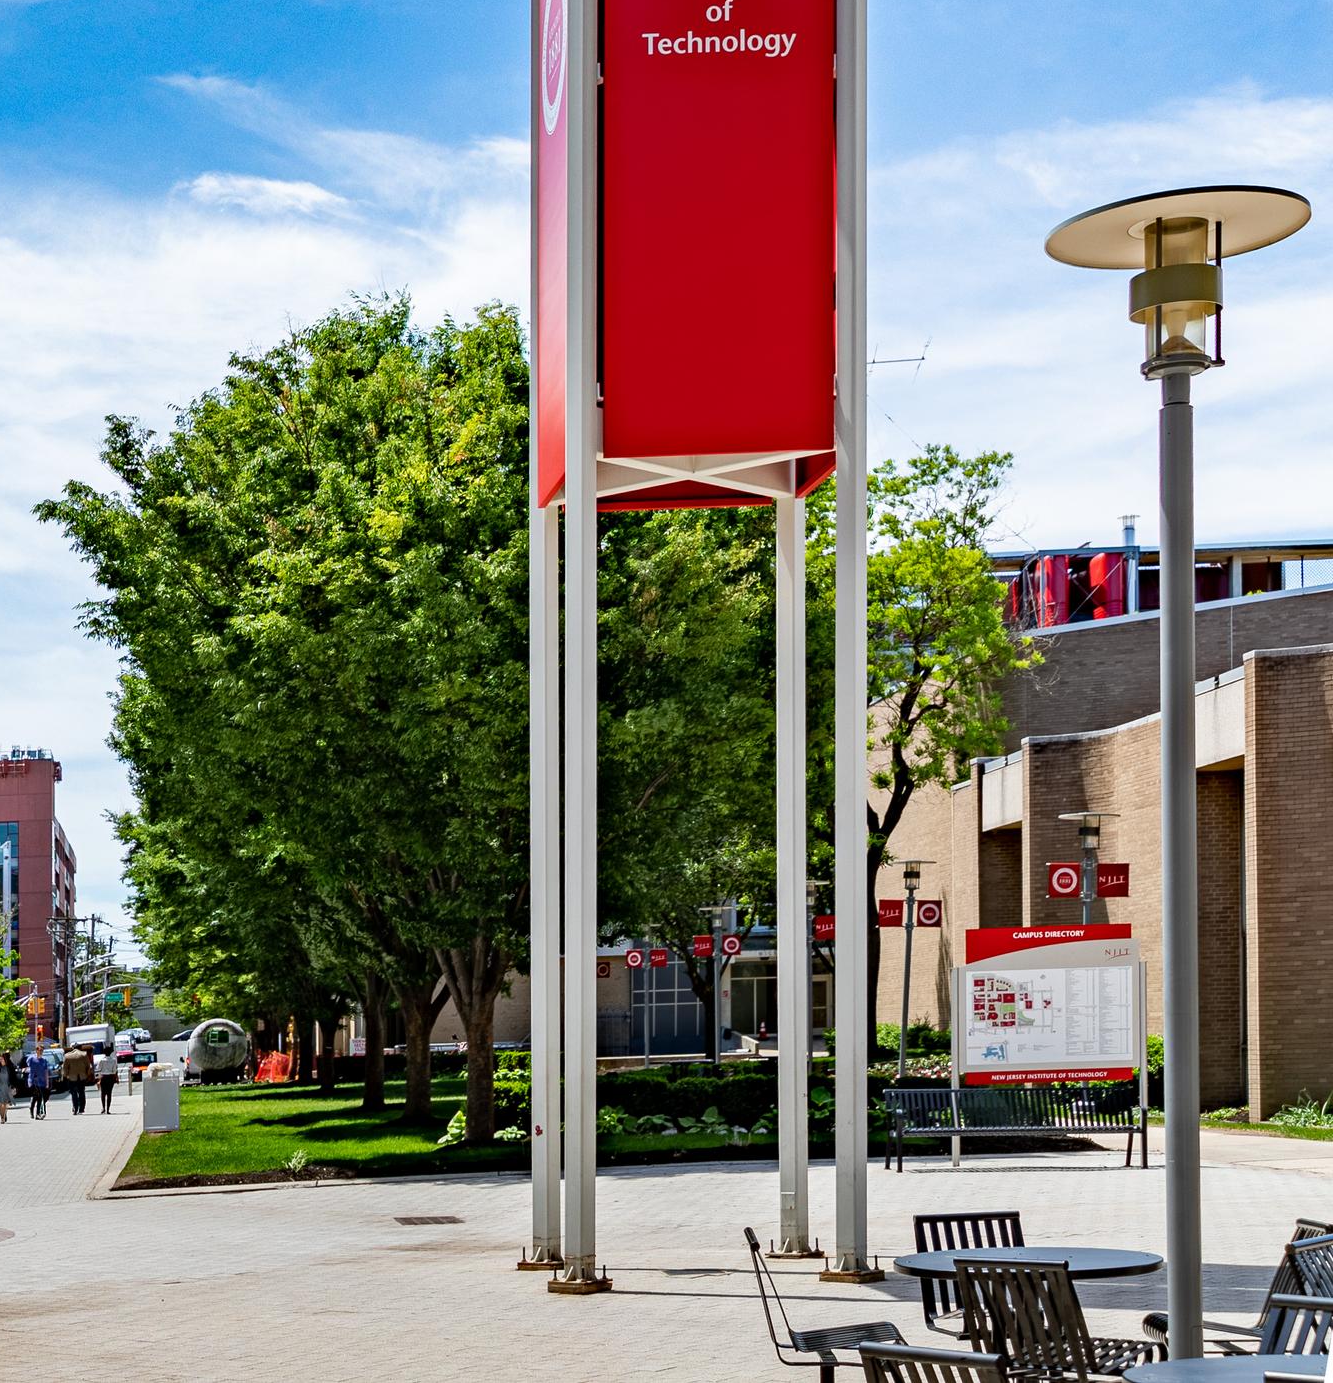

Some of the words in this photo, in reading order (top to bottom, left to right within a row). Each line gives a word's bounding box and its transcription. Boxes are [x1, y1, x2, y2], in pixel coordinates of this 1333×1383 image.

[706, 0, 733, 22] of
[642, 31, 797, 58] Technology
[1013, 930, 1043, 939] CAMPUS
[1045, 930, 1085, 938] DIRECTORY
[1104, 948, 1130, 956] NJIT
